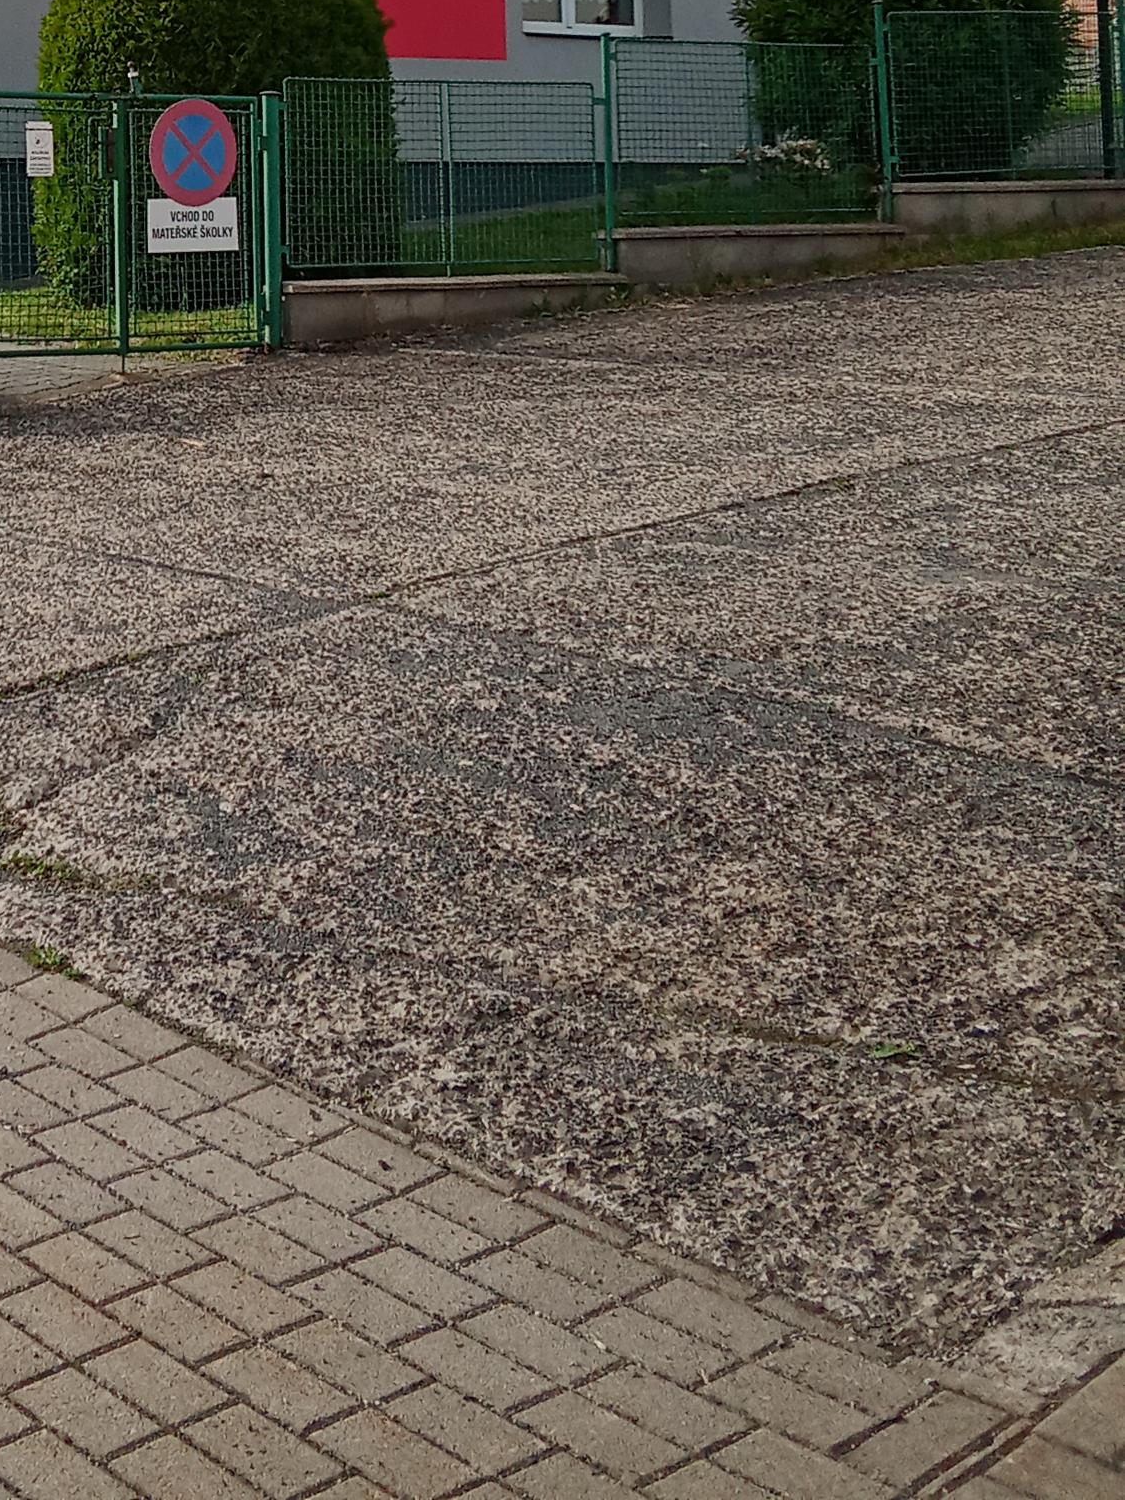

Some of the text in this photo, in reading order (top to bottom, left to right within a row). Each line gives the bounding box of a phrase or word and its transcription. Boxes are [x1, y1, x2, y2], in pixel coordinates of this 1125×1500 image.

[170, 210, 215, 222] VCHOD DO
[152, 224, 234, 239] MATEŘSKÉ ŠKOLKY
